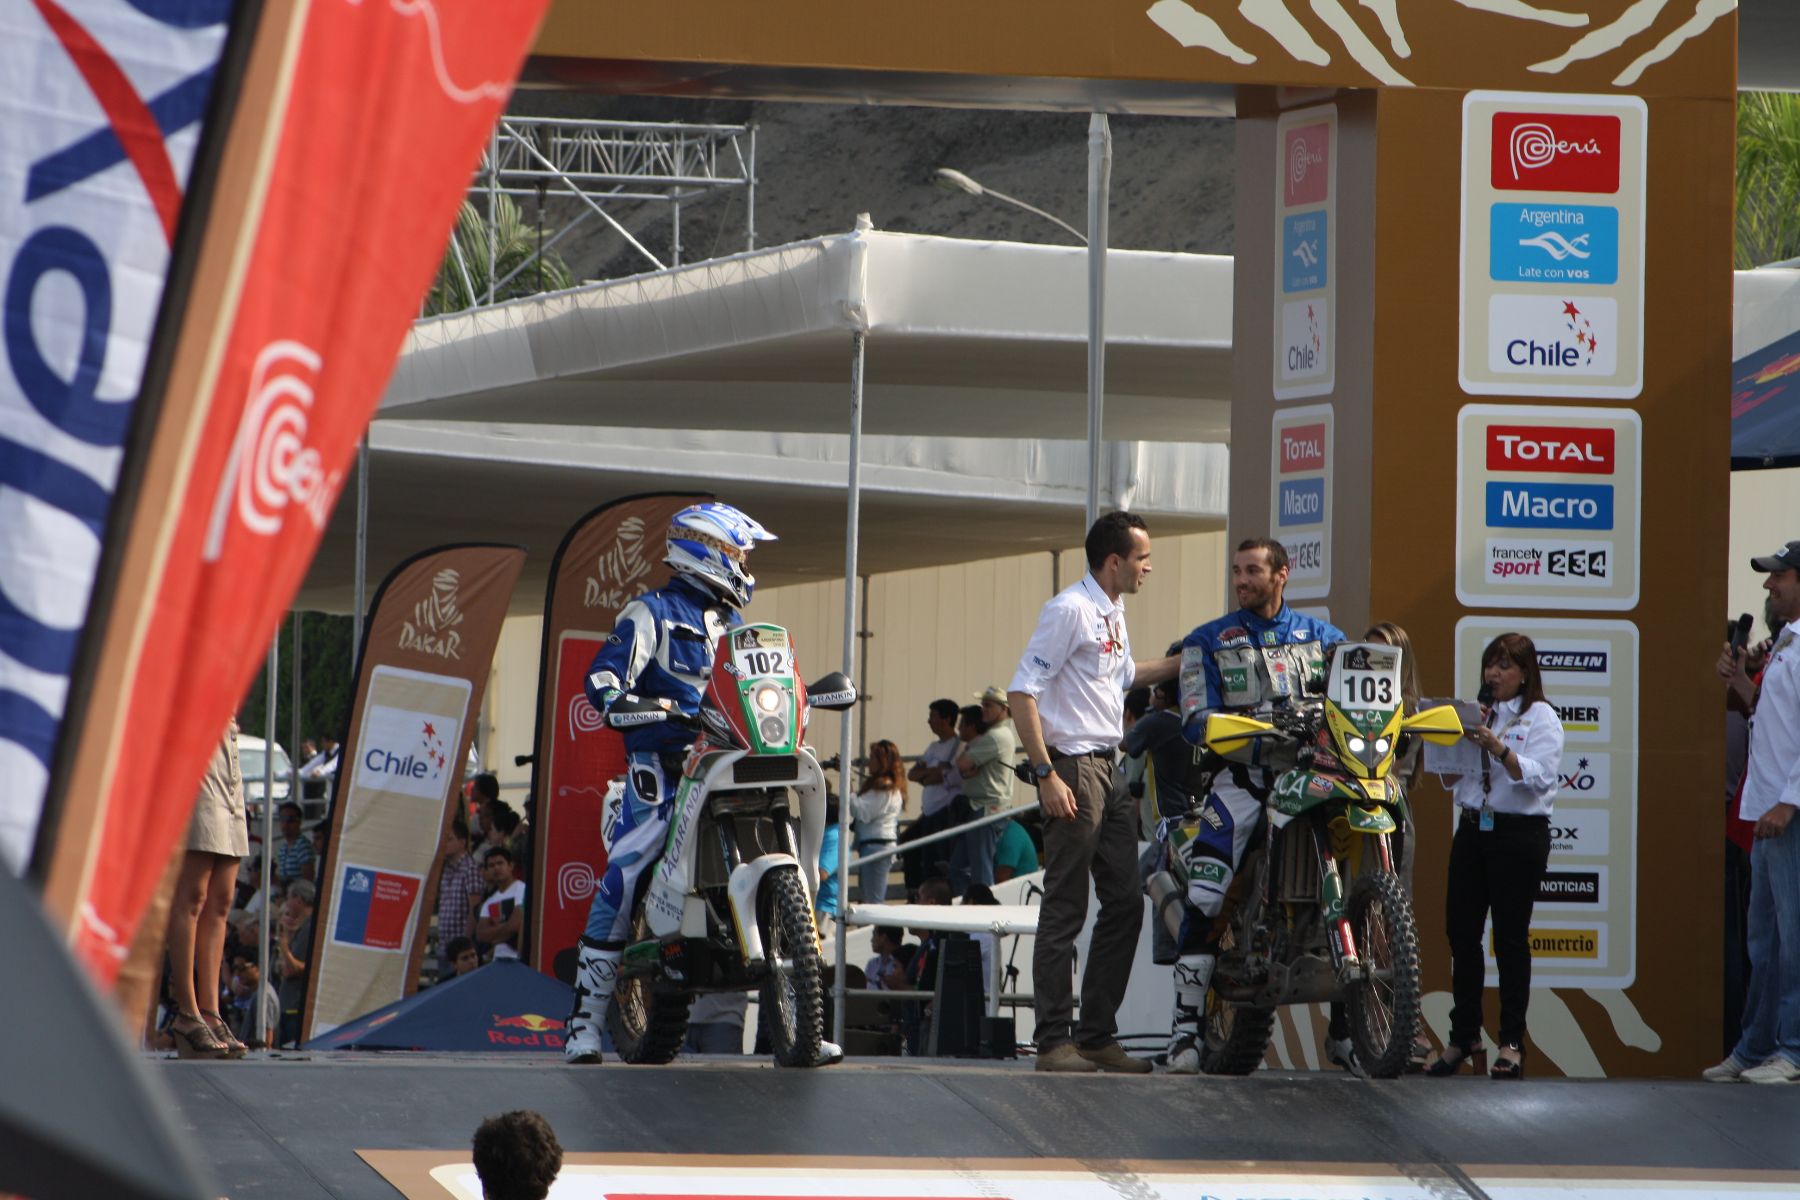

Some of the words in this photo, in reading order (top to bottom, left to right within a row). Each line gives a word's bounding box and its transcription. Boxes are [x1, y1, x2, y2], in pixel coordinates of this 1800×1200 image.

[1510, 123, 1601, 180] Perú
[1520, 208, 1584, 227] Argentina
[1519, 267, 1541, 278] Late
[1544, 269, 1564, 279] con
[1566, 269, 1590, 280] vos
[1288, 344, 1314, 370] Chile
[1507, 340, 1579, 367] Chile
[1497, 435, 1604, 462] TOTAL
[1285, 490, 1319, 516] Macro
[1502, 490, 1597, 519] Macro
[1492, 547, 1542, 559] francetv
[1492, 559, 1541, 577] sport
[399, 621, 460, 660] DAKAR
[744, 652, 784, 675] 102
[1537, 655, 1603, 667] ICHELIN
[817, 692, 853, 702] RANKIN
[1344, 676, 1392, 703] 103
[623, 713, 659, 721] RANKIN
[366, 749, 428, 779] Chile
[1279, 771, 1306, 799] CA
[1203, 863, 1220, 877] CA
[1540, 881, 1594, 893] NOTICIAS
[1528, 935, 1594, 952] omercio
[488, 1030, 539, 1047] Red
